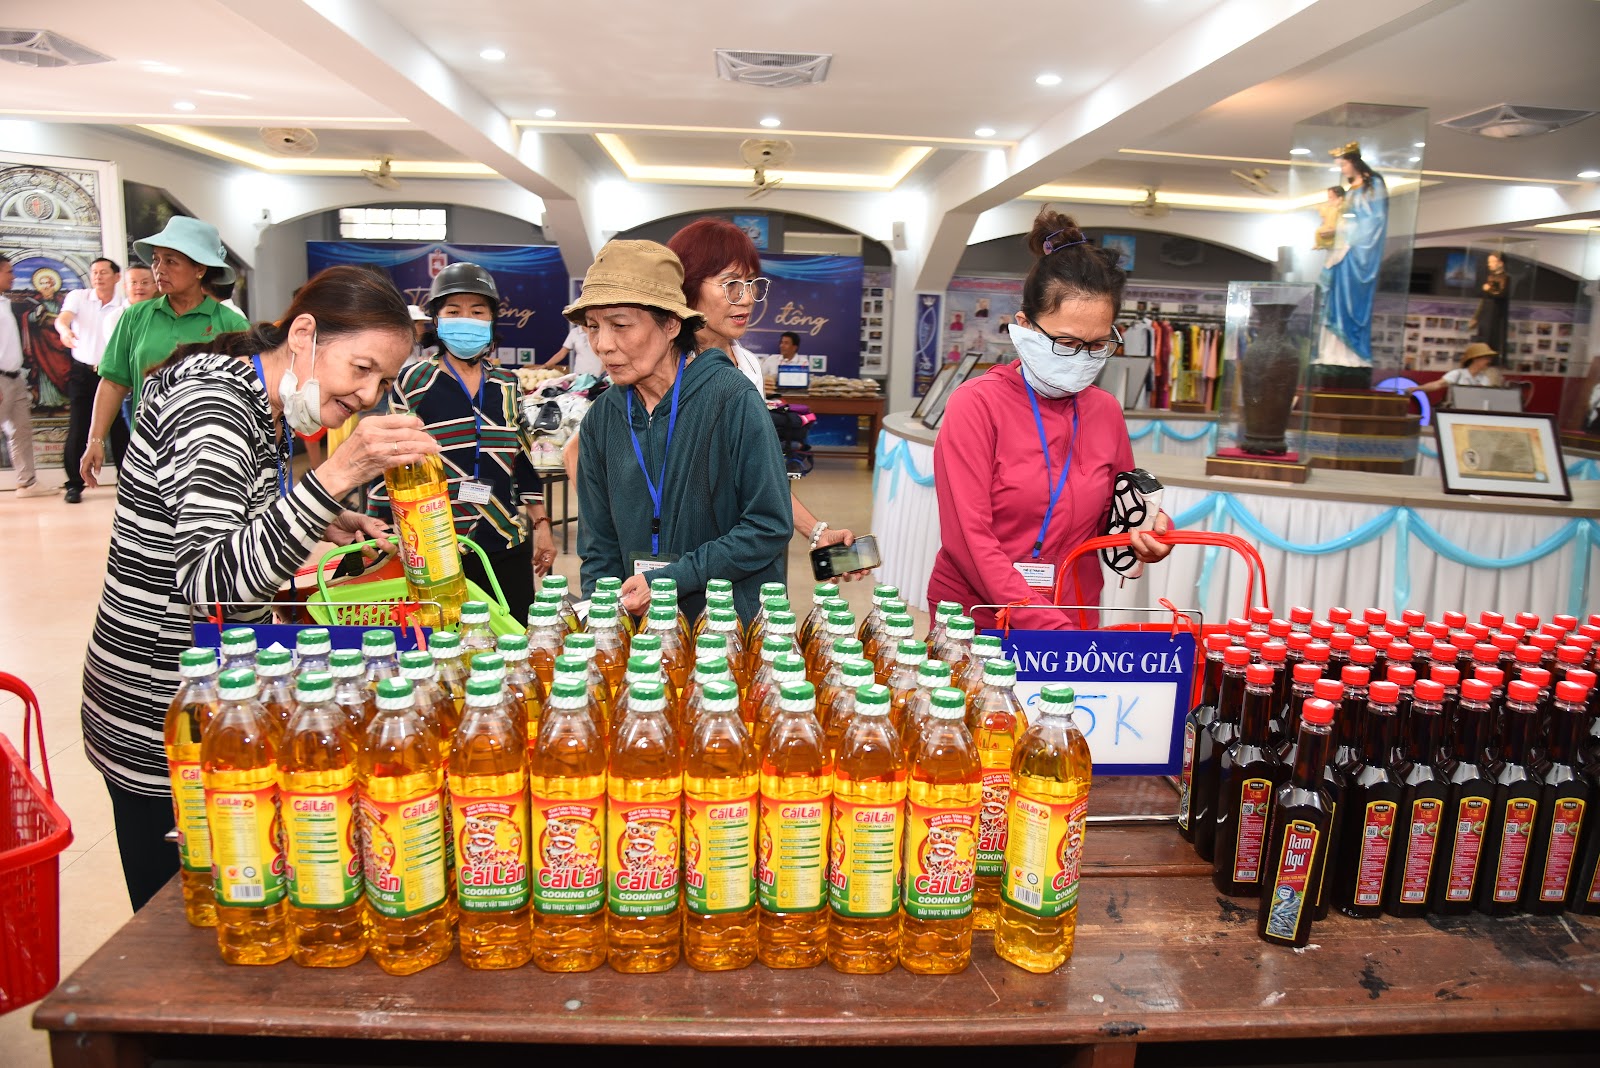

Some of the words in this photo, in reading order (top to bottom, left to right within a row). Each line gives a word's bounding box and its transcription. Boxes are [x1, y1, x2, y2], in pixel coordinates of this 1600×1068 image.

[498, 296, 536, 329] ồng
[776, 301, 829, 336] đồng
[1064, 641, 1138, 673] ĐỒNG
[1141, 646, 1183, 674] GIÁ
[1288, 834, 1312, 849] Nam
[464, 888, 506, 896] COOKING
[509, 884, 523, 894] OIL
[542, 890, 584, 898] COOKING
[586, 888, 600, 897] OIL
[664, 889, 676, 898] OIL
[688, 887, 698, 897] OIL
[759, 883, 769, 894] OIL
[832, 887, 841, 897] OIL
[918, 896, 960, 904] COOKING
[962, 893, 972, 902] OIL
